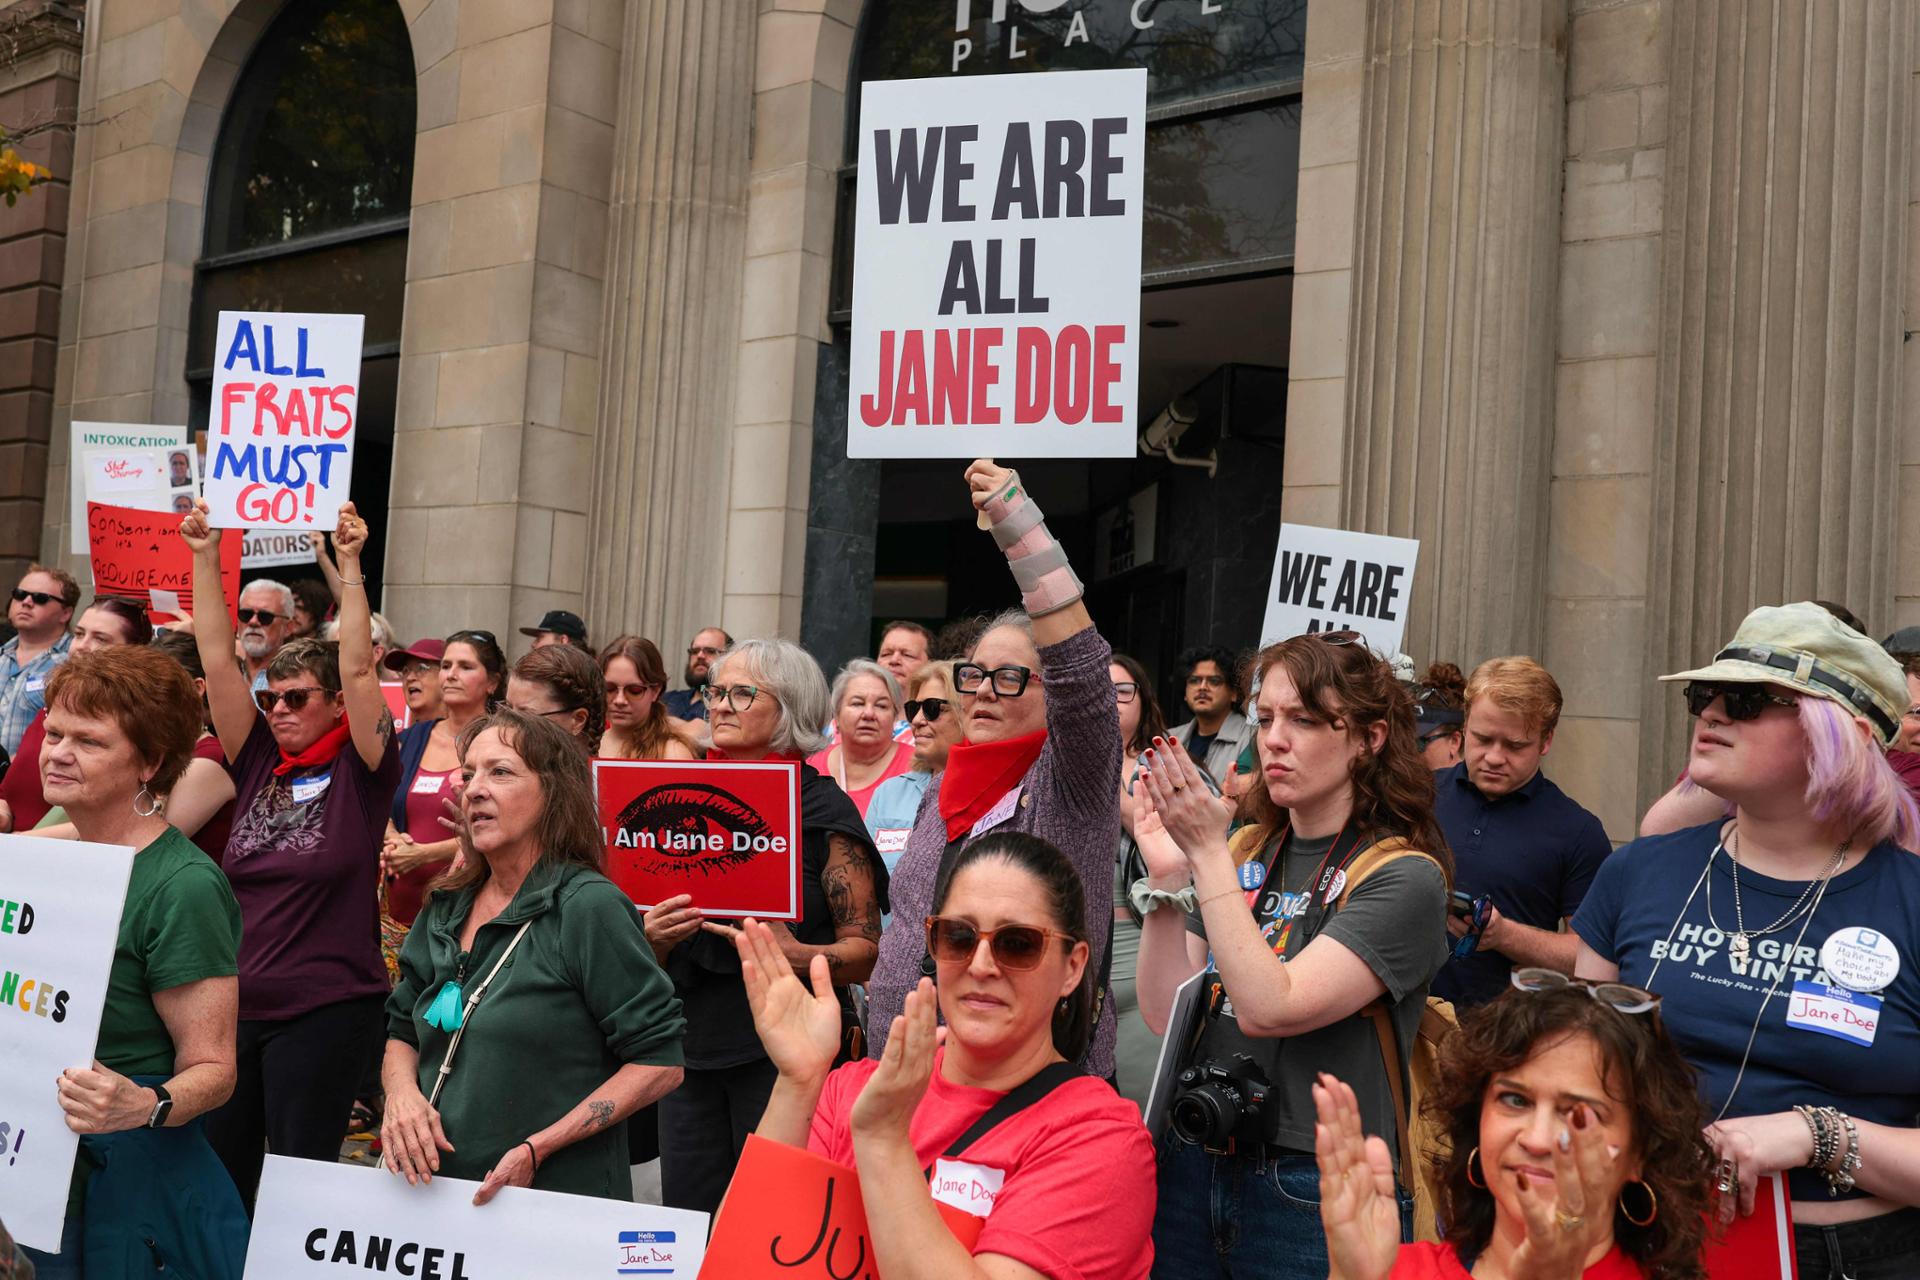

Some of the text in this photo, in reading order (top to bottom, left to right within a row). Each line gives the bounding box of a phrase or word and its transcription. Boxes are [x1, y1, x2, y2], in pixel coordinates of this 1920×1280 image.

[874, 117, 1128, 225] WE ARE
[937, 238, 1050, 316] ALL
[223, 319, 326, 379] ALL
[860, 324, 1126, 428] JANE DOE
[220, 382, 355, 440] FRATS
[84, 433, 178, 447] INTOXICATION
[213, 442, 348, 489] MUST
[235, 482, 316, 524] GO!
[242, 534, 311, 557] DATORS
[94, 558, 191, 588] REQUIREME
[1278, 551, 1404, 621] WE ARE
[975, 806, 1015, 833] JANE
[614, 827, 656, 848] Am
[662, 830, 724, 852] Jane
[732, 831, 787, 853] Doe
[1318, 866, 1335, 891] EOS
[0, 899, 35, 935] ED
[1650, 939, 1717, 967] BUY
[1728, 953, 1833, 988] VINTA
[1757, 939, 1823, 967] GIR
[0, 970, 70, 1023] NCES
[1826, 986, 1852, 999] Hello
[1793, 996, 1840, 1023] Jane
[1843, 1007, 1875, 1032] Doe
[935, 1175, 967, 1195] Jane
[304, 1227, 470, 1280] CANCEL
[620, 1245, 650, 1265] Jane
